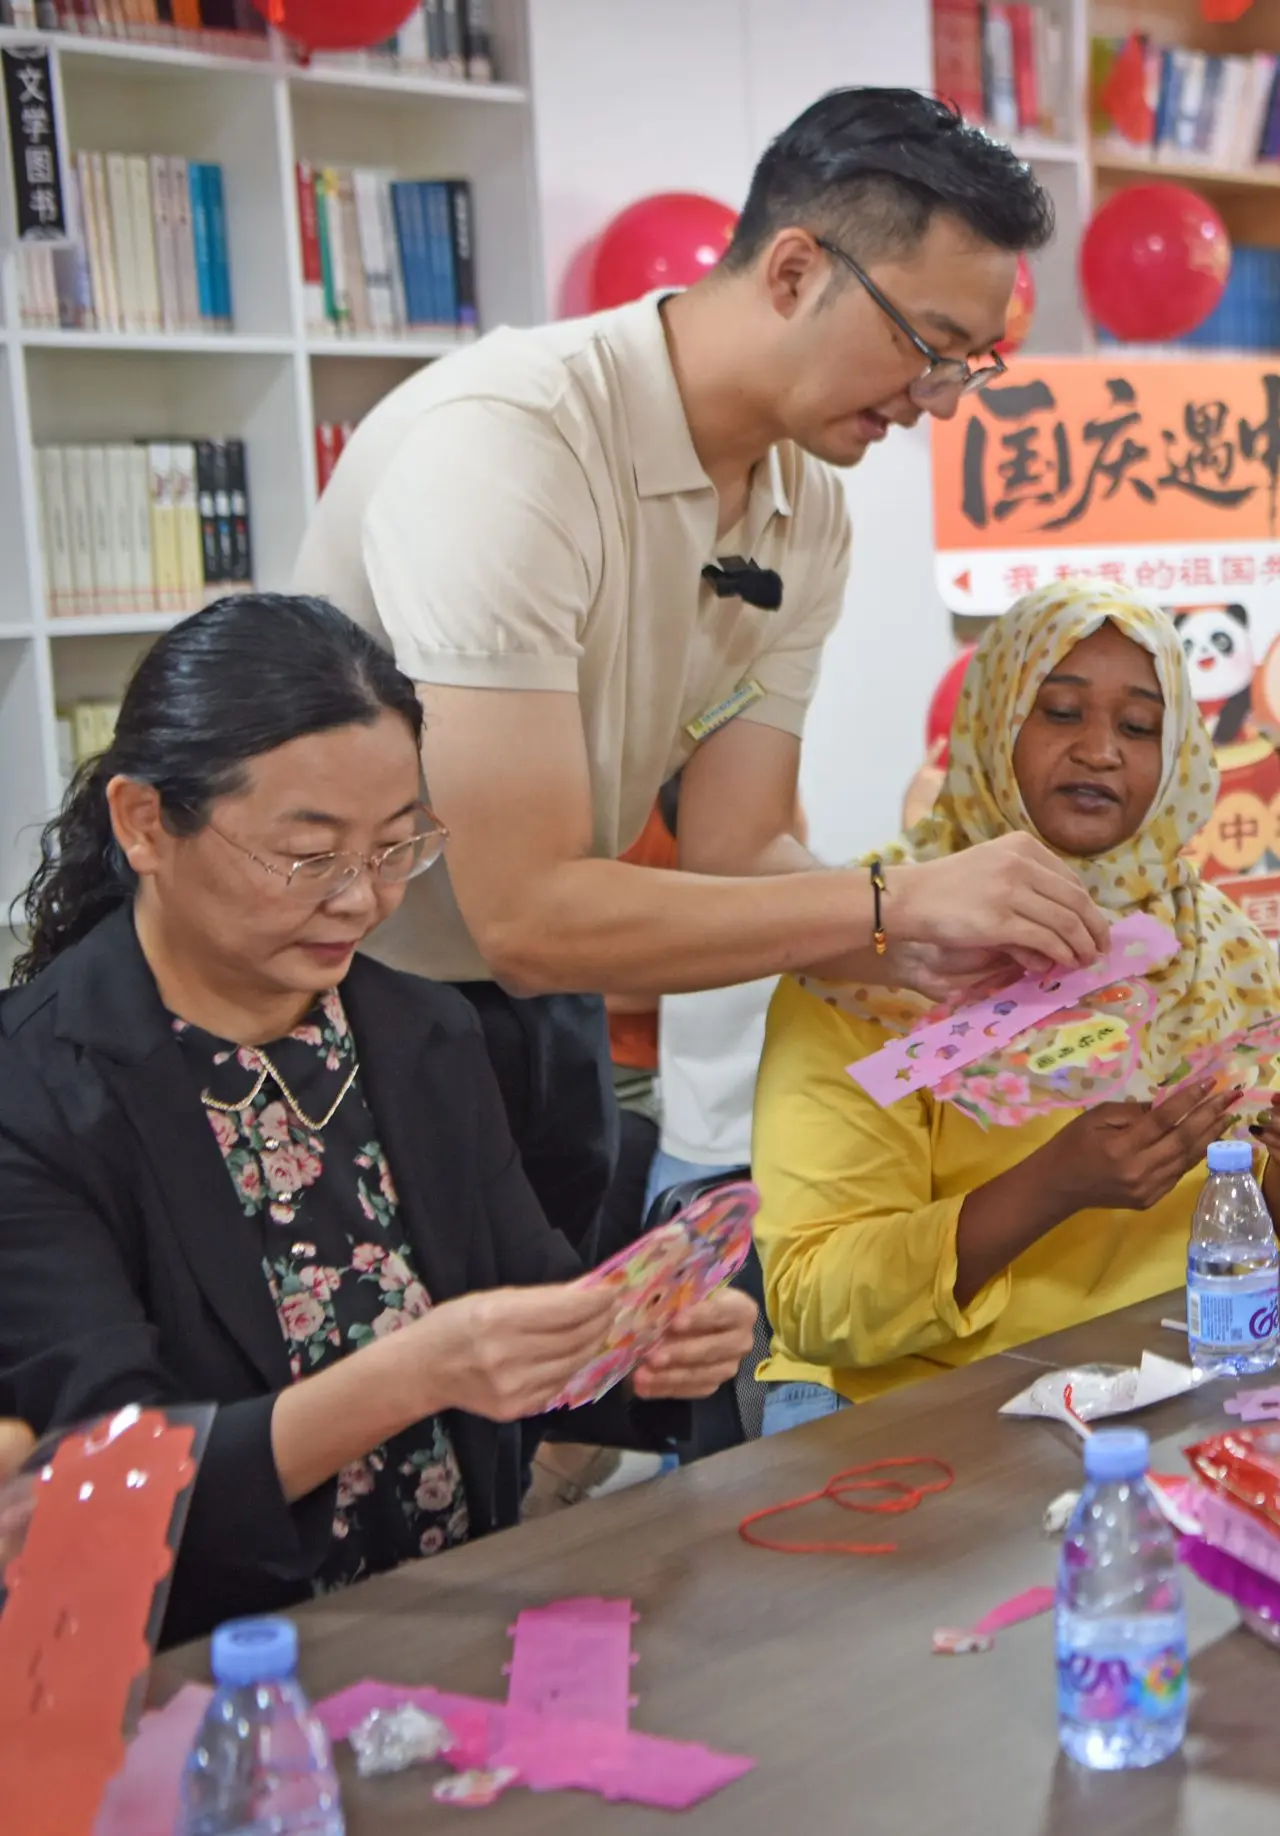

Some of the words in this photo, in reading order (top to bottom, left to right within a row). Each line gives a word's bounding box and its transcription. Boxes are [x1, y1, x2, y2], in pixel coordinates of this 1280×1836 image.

[16, 63, 58, 224] 文学图书
[1218, 812, 1259, 853] 中
